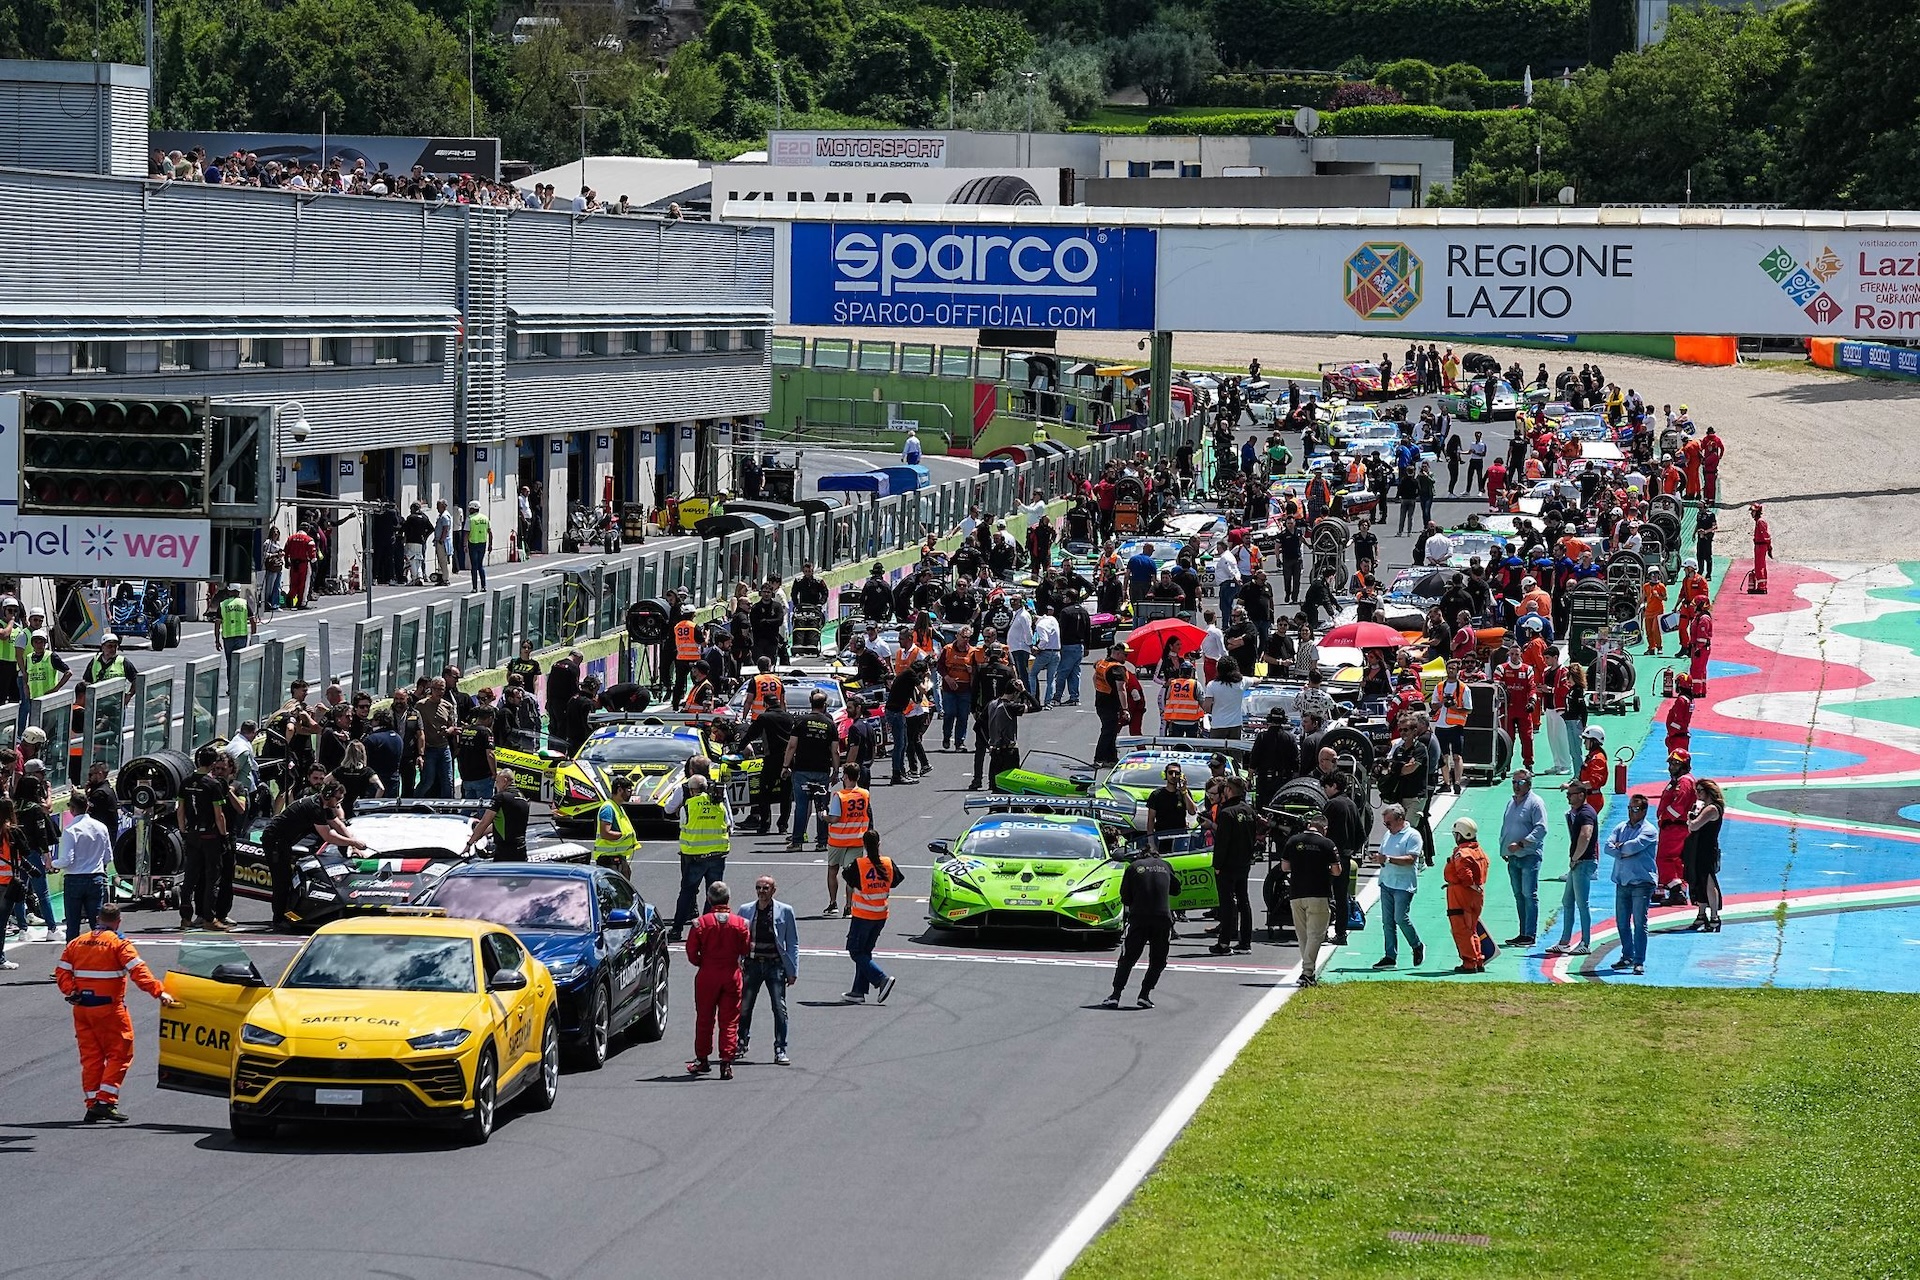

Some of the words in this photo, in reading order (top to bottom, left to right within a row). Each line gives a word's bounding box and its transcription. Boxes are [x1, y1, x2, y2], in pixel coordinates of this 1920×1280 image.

[817, 138, 944, 158] MOTORSPORT
[835, 233, 1098, 296] sparco
[1446, 244, 1633, 277] REGIONE
[1860, 283, 1898, 293] ETERNAL
[1446, 285, 1572, 318] LAZIO
[833, 302, 1096, 327] SPARCO-OFFICIAL.COM
[1868, 347, 1890, 363] sparco
[641, 433, 650, 442] 14
[681, 428, 691, 438] 12
[552, 442, 562, 453] 16
[599, 437, 607, 447] 15
[476, 449, 485, 460] 18
[404, 456, 414, 467] 19
[340, 462, 353, 474] 20
[122, 532, 200, 568] way
[677, 627, 690, 637] 38
[761, 681, 778, 692] 28
[1173, 682, 1190, 693] 94
[1118, 763, 1152, 771] 109
[847, 798, 865, 812] 33
[970, 829, 1011, 840] 166
[301, 1015, 363, 1024] SAFETY
[367, 1016, 401, 1027] CAR
[159, 1018, 191, 1042] ETY
[194, 1025, 230, 1050] CAR
